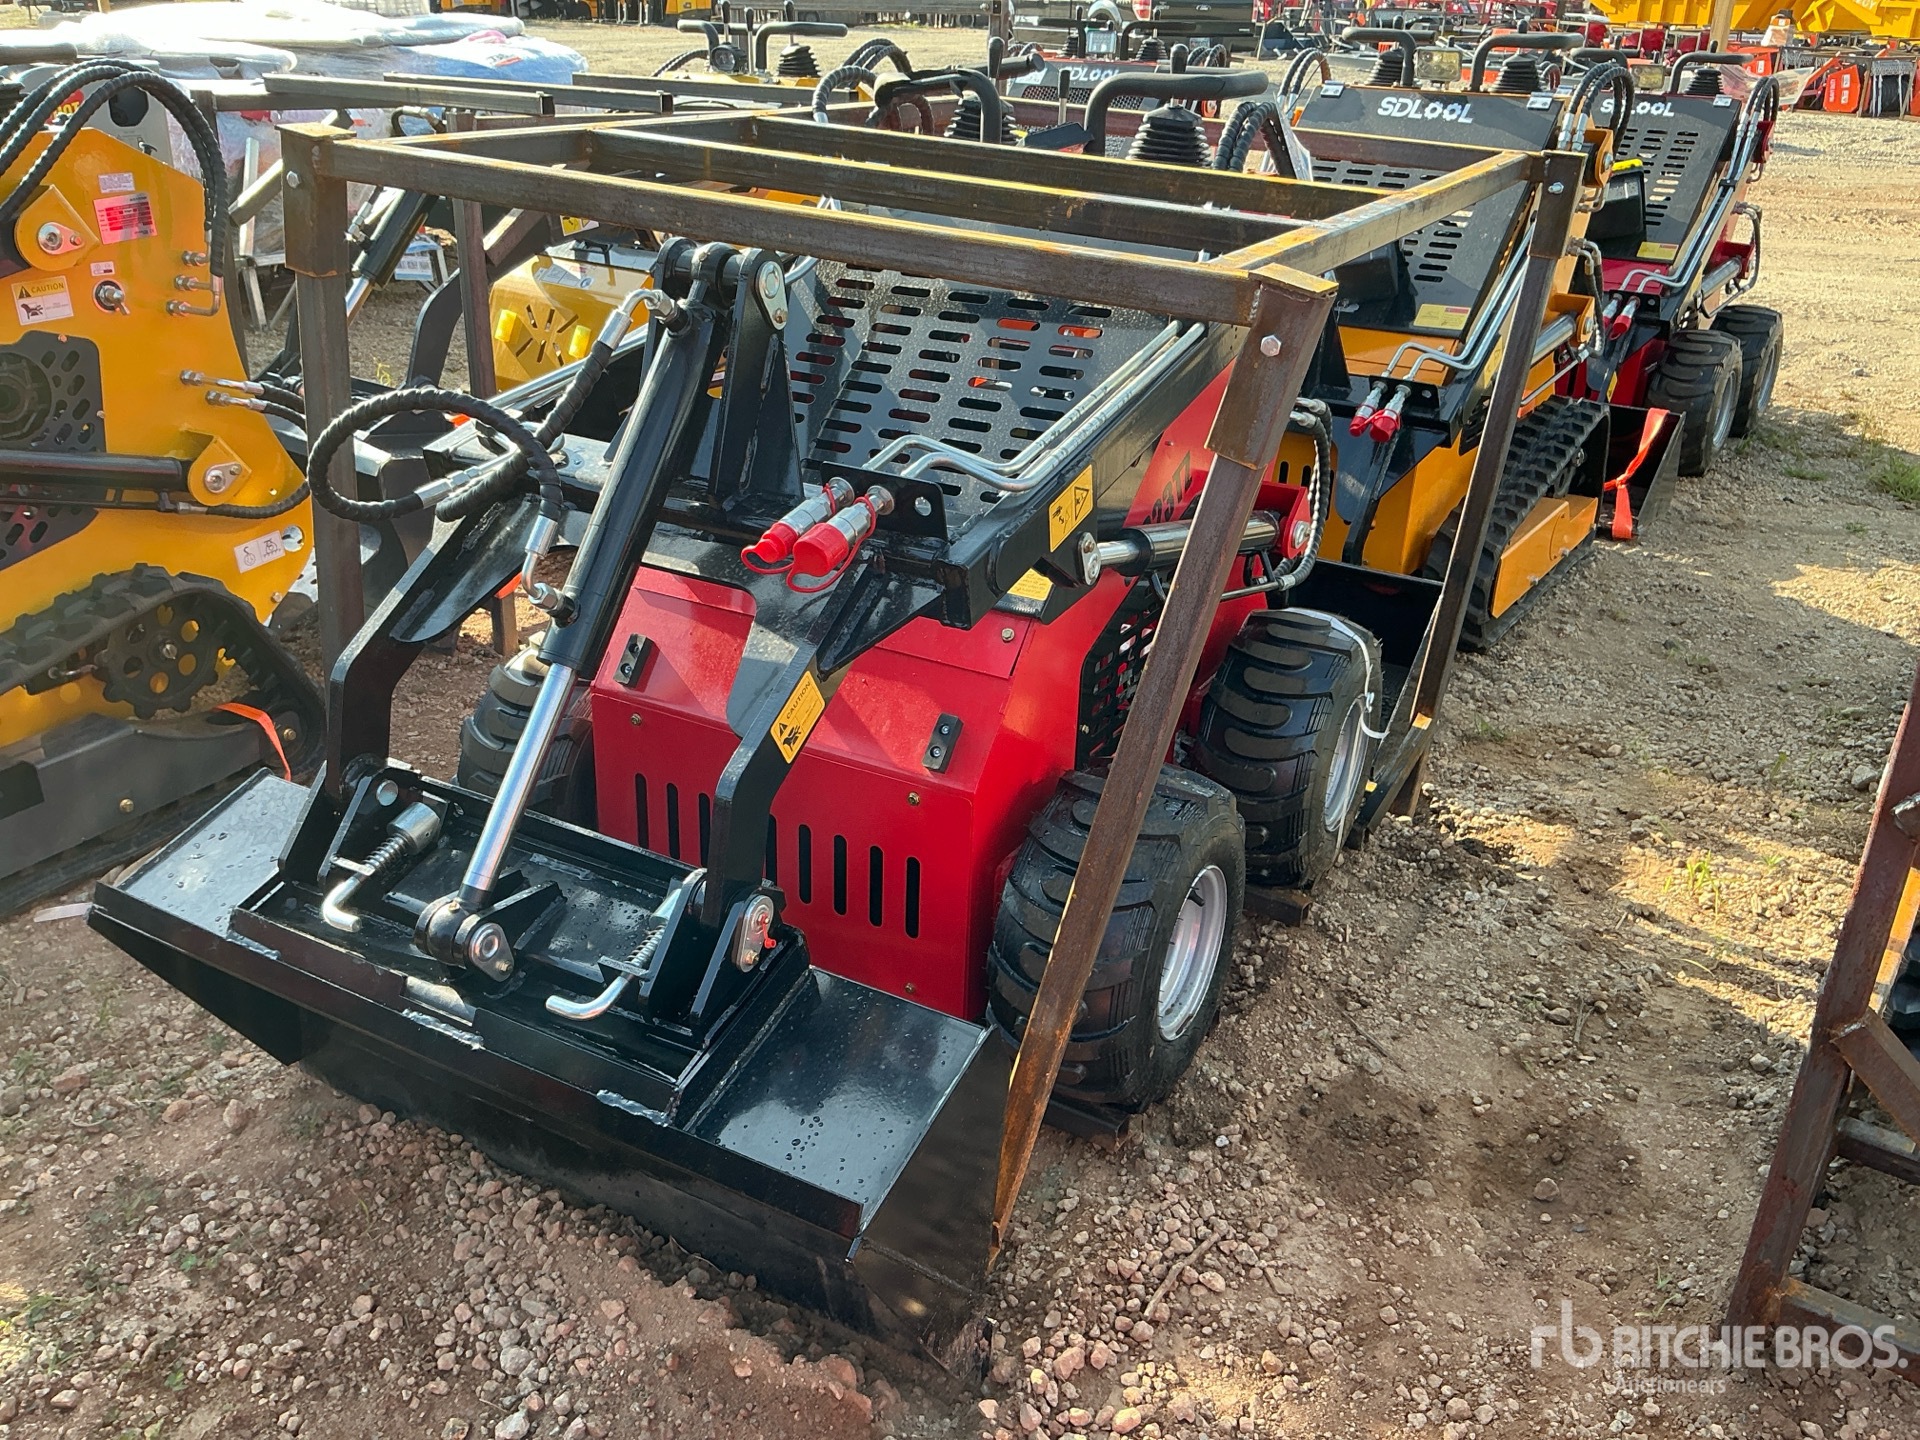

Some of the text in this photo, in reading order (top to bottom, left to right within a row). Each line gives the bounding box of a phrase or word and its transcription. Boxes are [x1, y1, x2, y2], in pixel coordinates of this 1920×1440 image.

[1377, 96, 1475, 124] SDLOOL
[1600, 98, 1675, 118] SOOL
[31, 282, 65, 294] CAUTION
[786, 681, 811, 720] CAUTION
